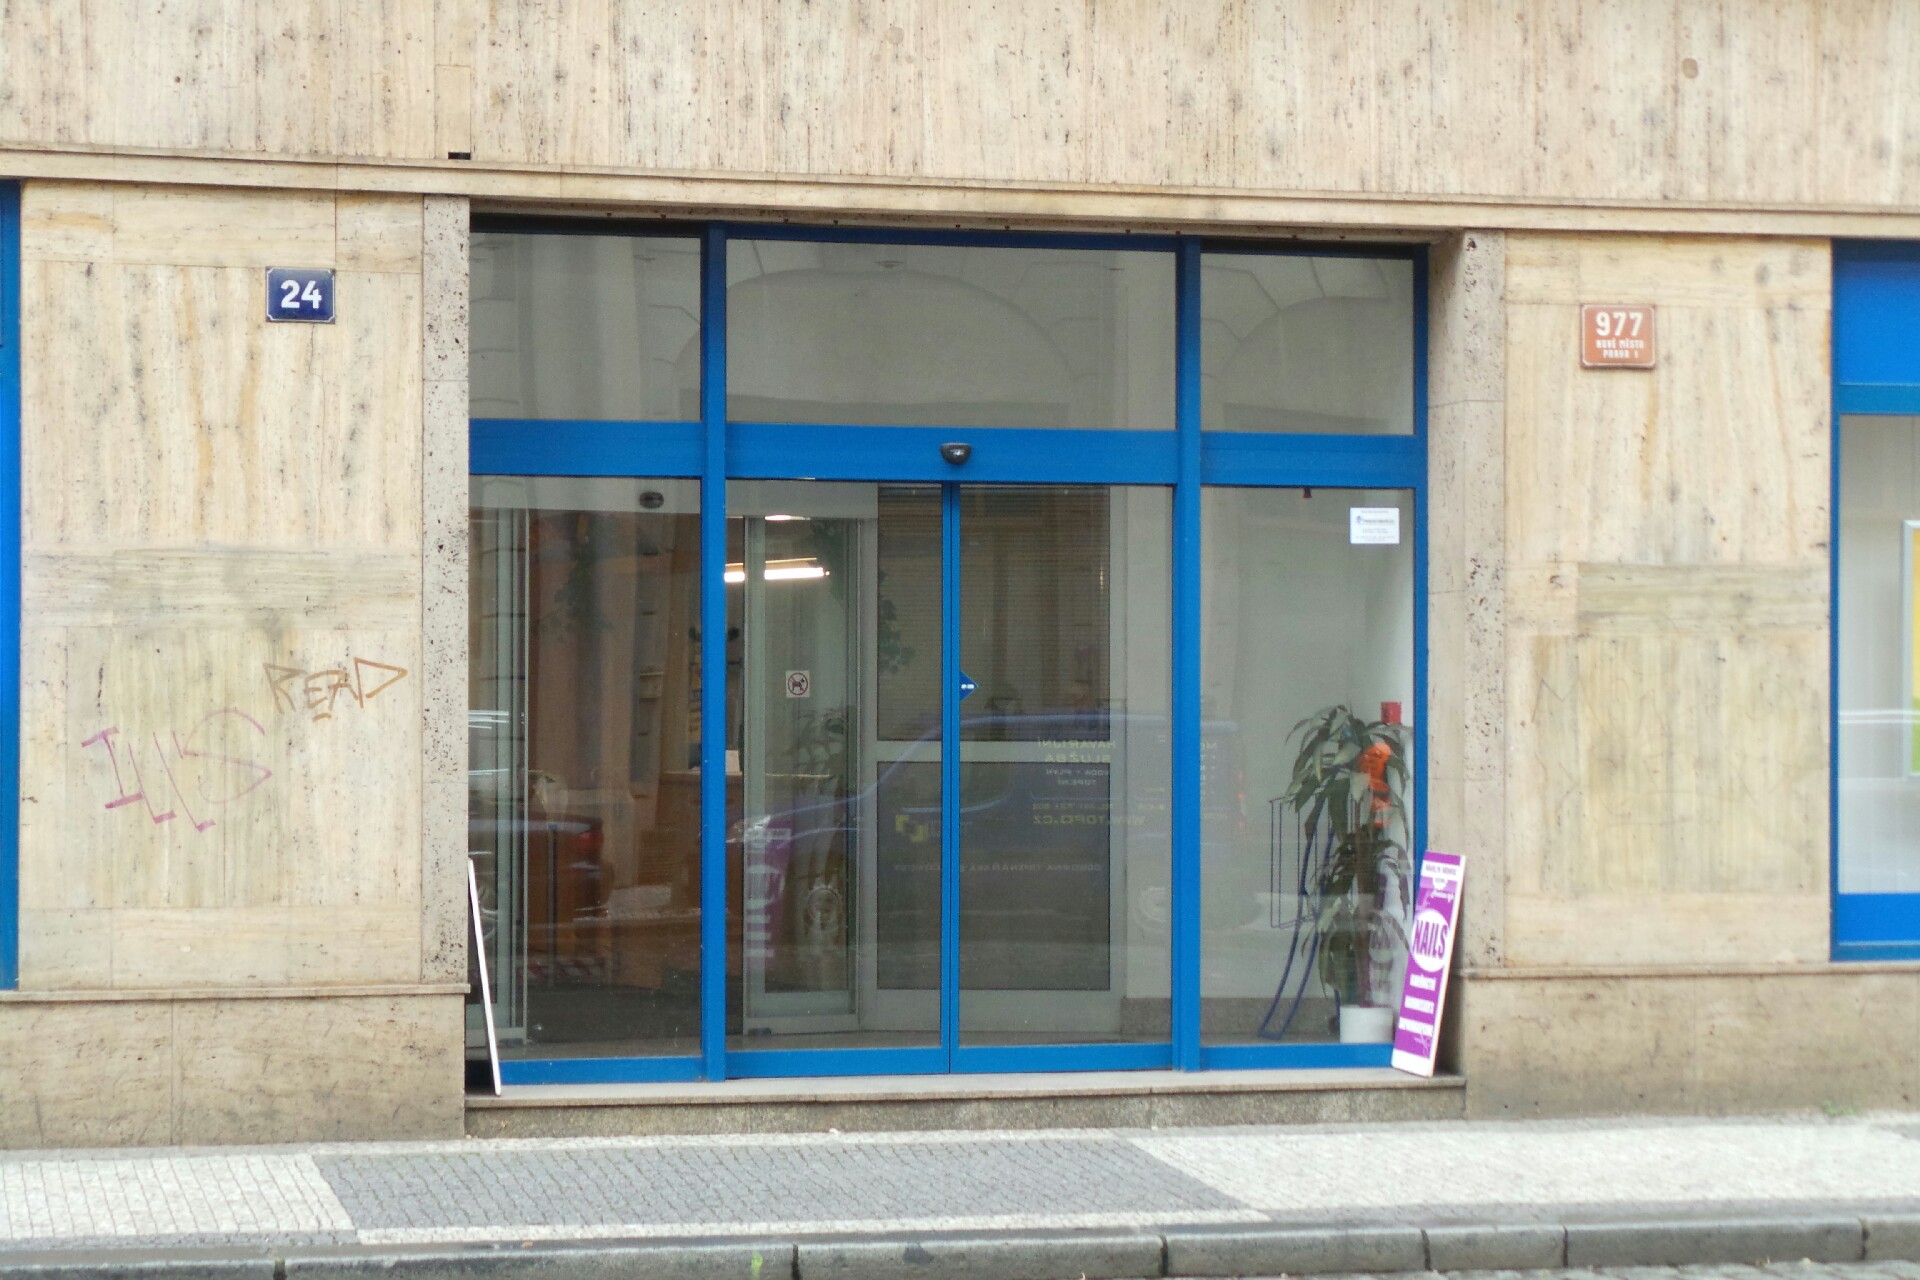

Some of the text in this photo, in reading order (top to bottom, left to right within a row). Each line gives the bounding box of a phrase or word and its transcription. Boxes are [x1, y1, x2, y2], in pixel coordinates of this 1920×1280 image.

[281, 279, 322, 309] 24
[1595, 311, 1644, 337] 977
[1595, 337, 1644, 349] NOVÉ MĚSTO
[1603, 349, 1630, 359] PRAHA
[1413, 919, 1448, 958] NAILS
